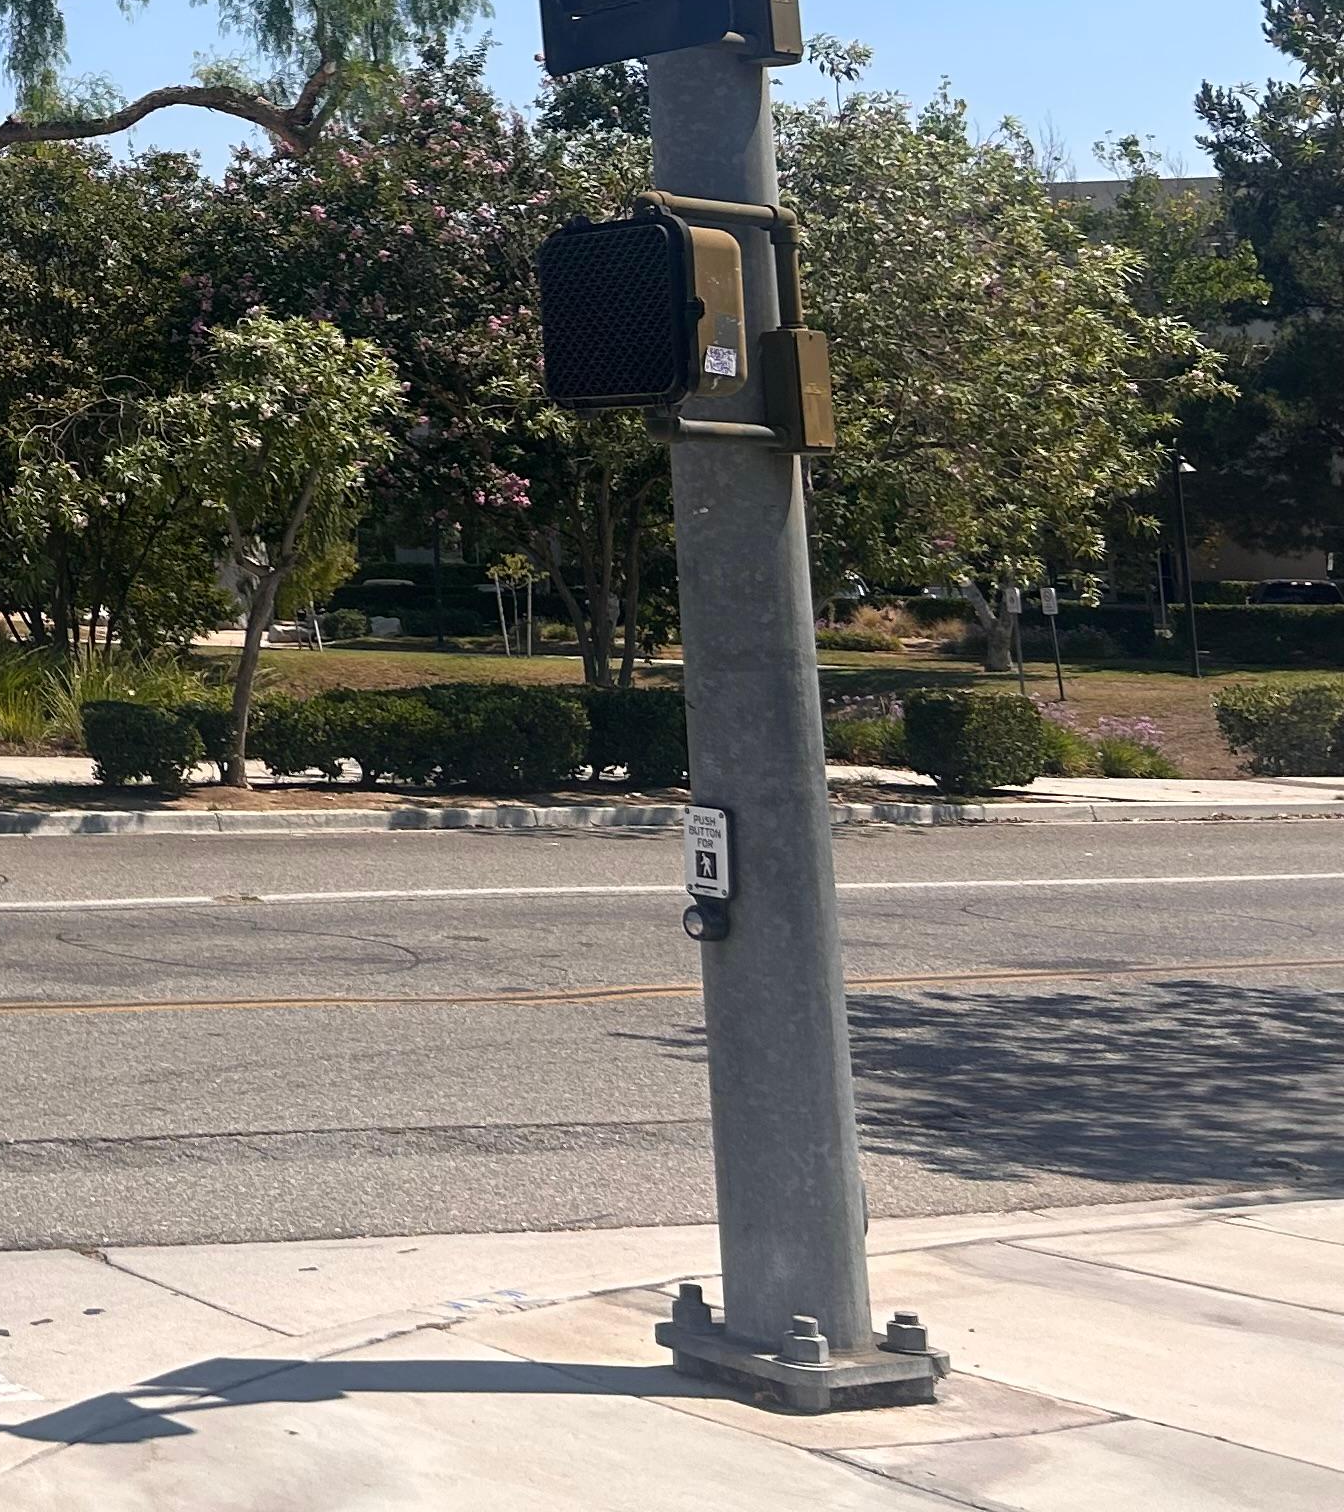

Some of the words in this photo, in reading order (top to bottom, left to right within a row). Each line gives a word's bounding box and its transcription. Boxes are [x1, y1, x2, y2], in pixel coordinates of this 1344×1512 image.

[693, 814, 716, 827] PUSH
[688, 824, 722, 839] BUTTON
[697, 837, 714, 849] FOR
